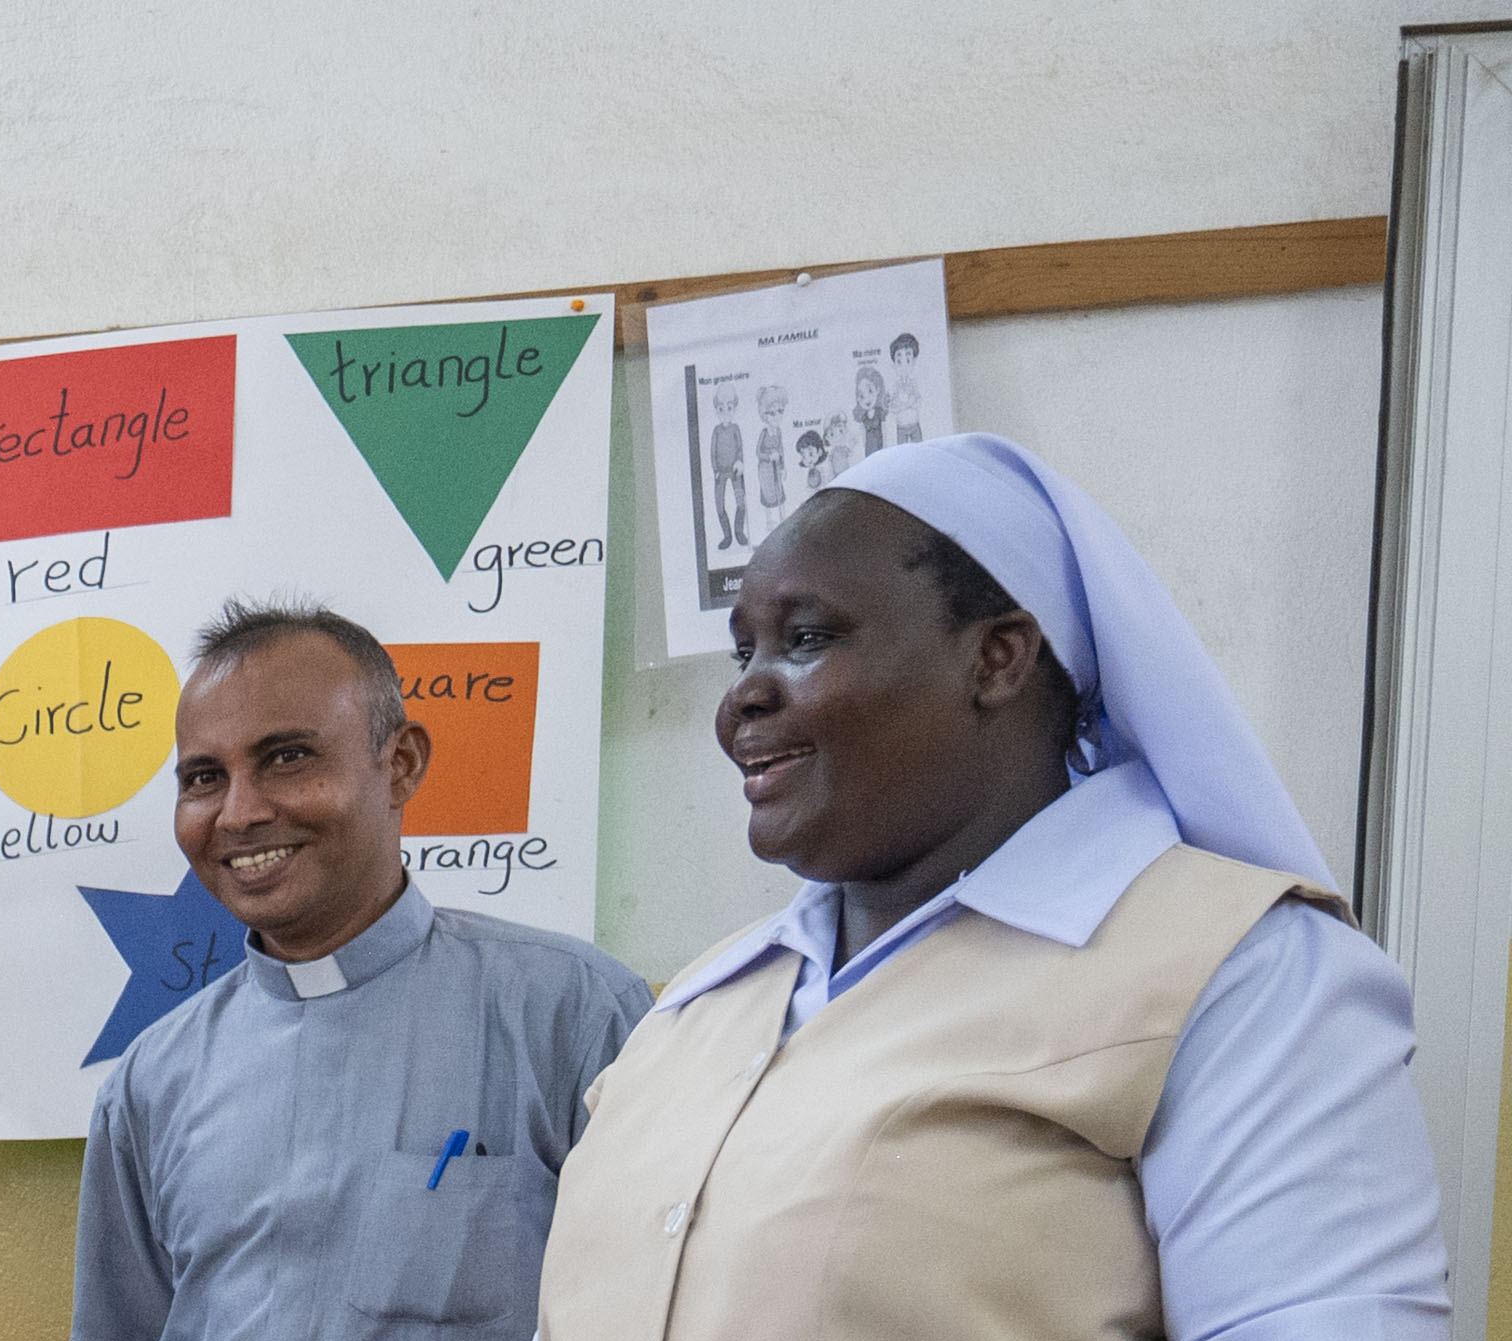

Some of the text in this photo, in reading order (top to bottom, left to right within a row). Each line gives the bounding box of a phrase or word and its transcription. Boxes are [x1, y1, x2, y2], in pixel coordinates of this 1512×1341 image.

[330, 326, 543, 416] triangle
[758, 337, 774, 347] MA
[8, 532, 111, 603] red
[468, 535, 604, 613] green
